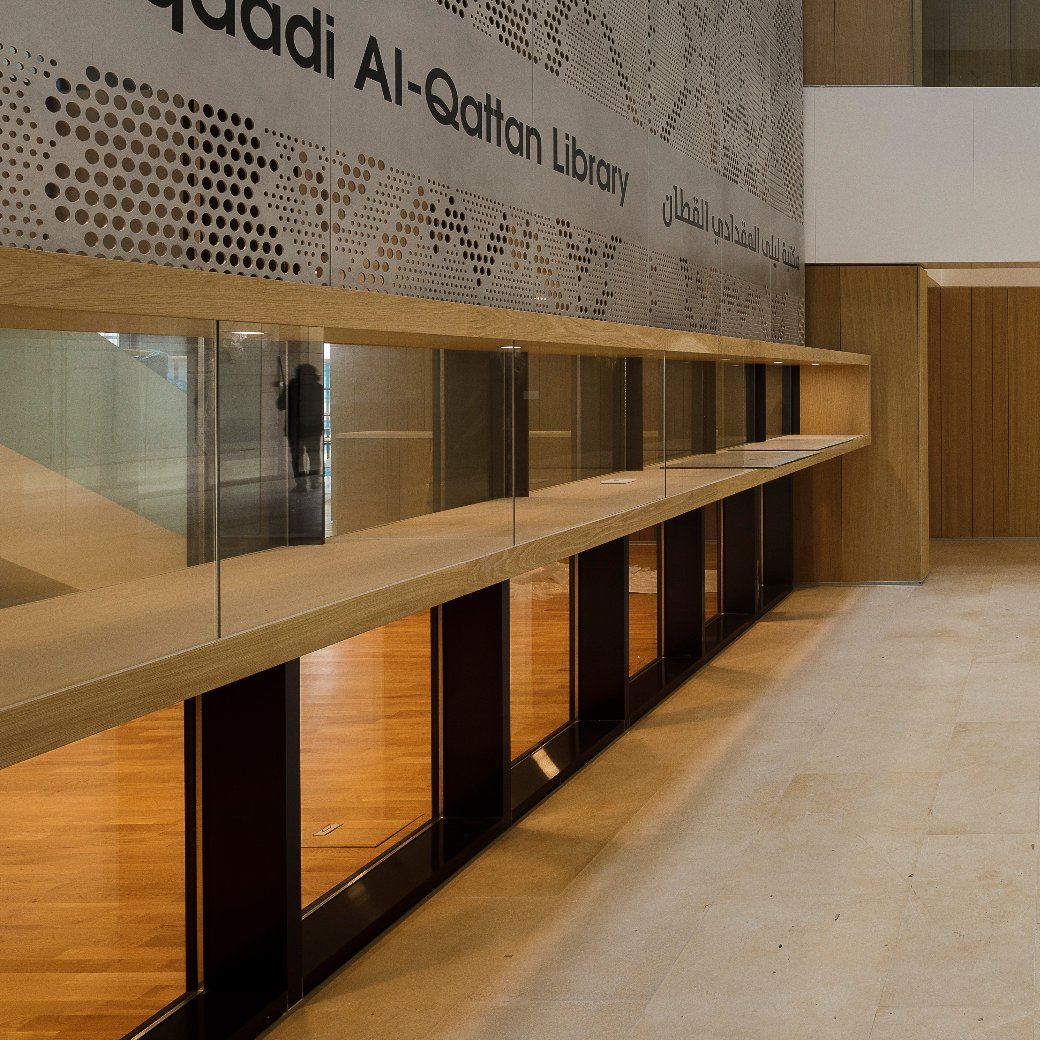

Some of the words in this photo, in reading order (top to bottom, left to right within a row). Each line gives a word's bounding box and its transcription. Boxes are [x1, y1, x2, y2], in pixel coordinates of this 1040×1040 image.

[354, 35, 542, 165] Al-Qattan
[553, 127, 630, 207] Library
[662, 185, 709, 232] القطان
[782, 241, 800, 272] مكتبة
